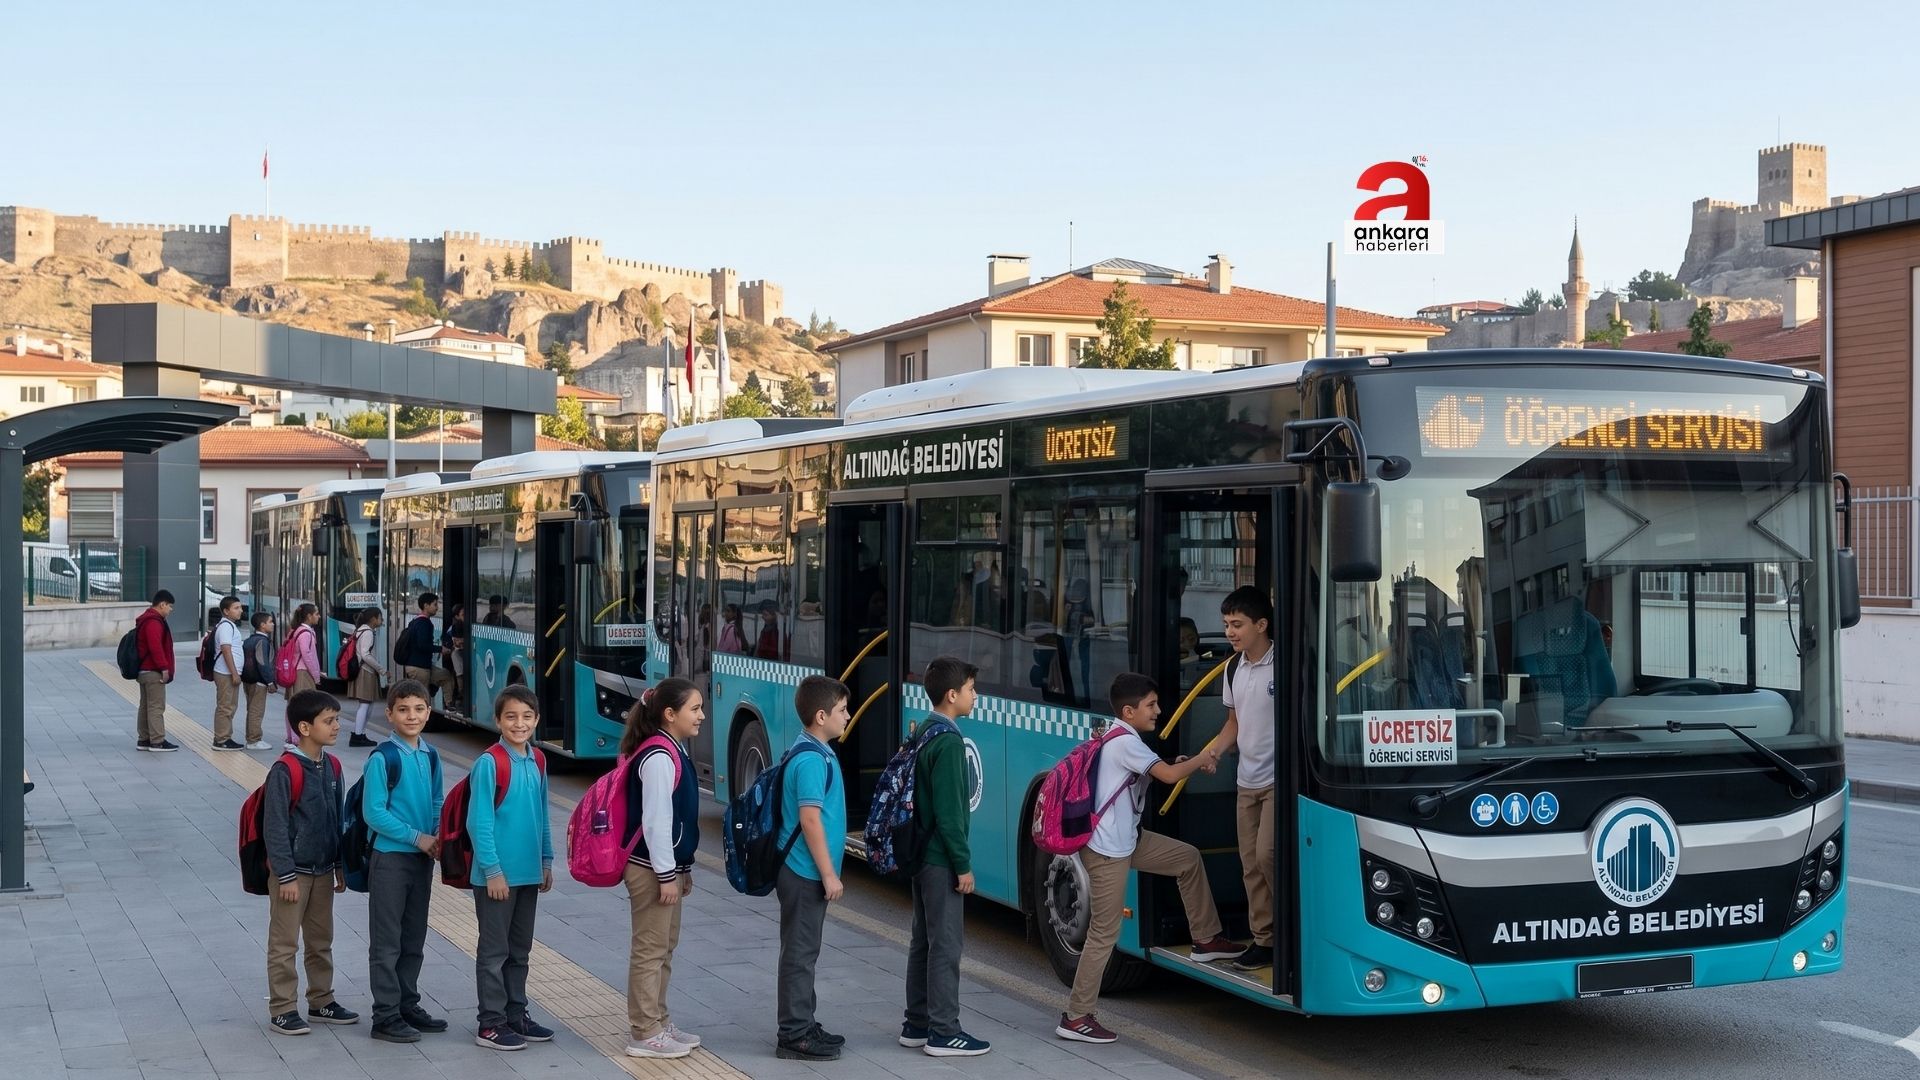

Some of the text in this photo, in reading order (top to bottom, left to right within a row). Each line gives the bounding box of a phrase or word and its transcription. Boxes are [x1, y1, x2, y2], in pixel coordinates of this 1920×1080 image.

[1045, 420, 1117, 462] ÜCRETSİZ
[1504, 396, 1763, 450] ÖĞRENCİ SERVİSİ
[843, 429, 1004, 480] ALTINDAĞ BELEDİYESİ
[1368, 715, 1453, 744] ÜCRETSİZ
[1369, 747, 1453, 763] ÖĞRENCİ SERVİSİ
[1492, 898, 1764, 944] ALTINDAĞ BELEDİYESİ
